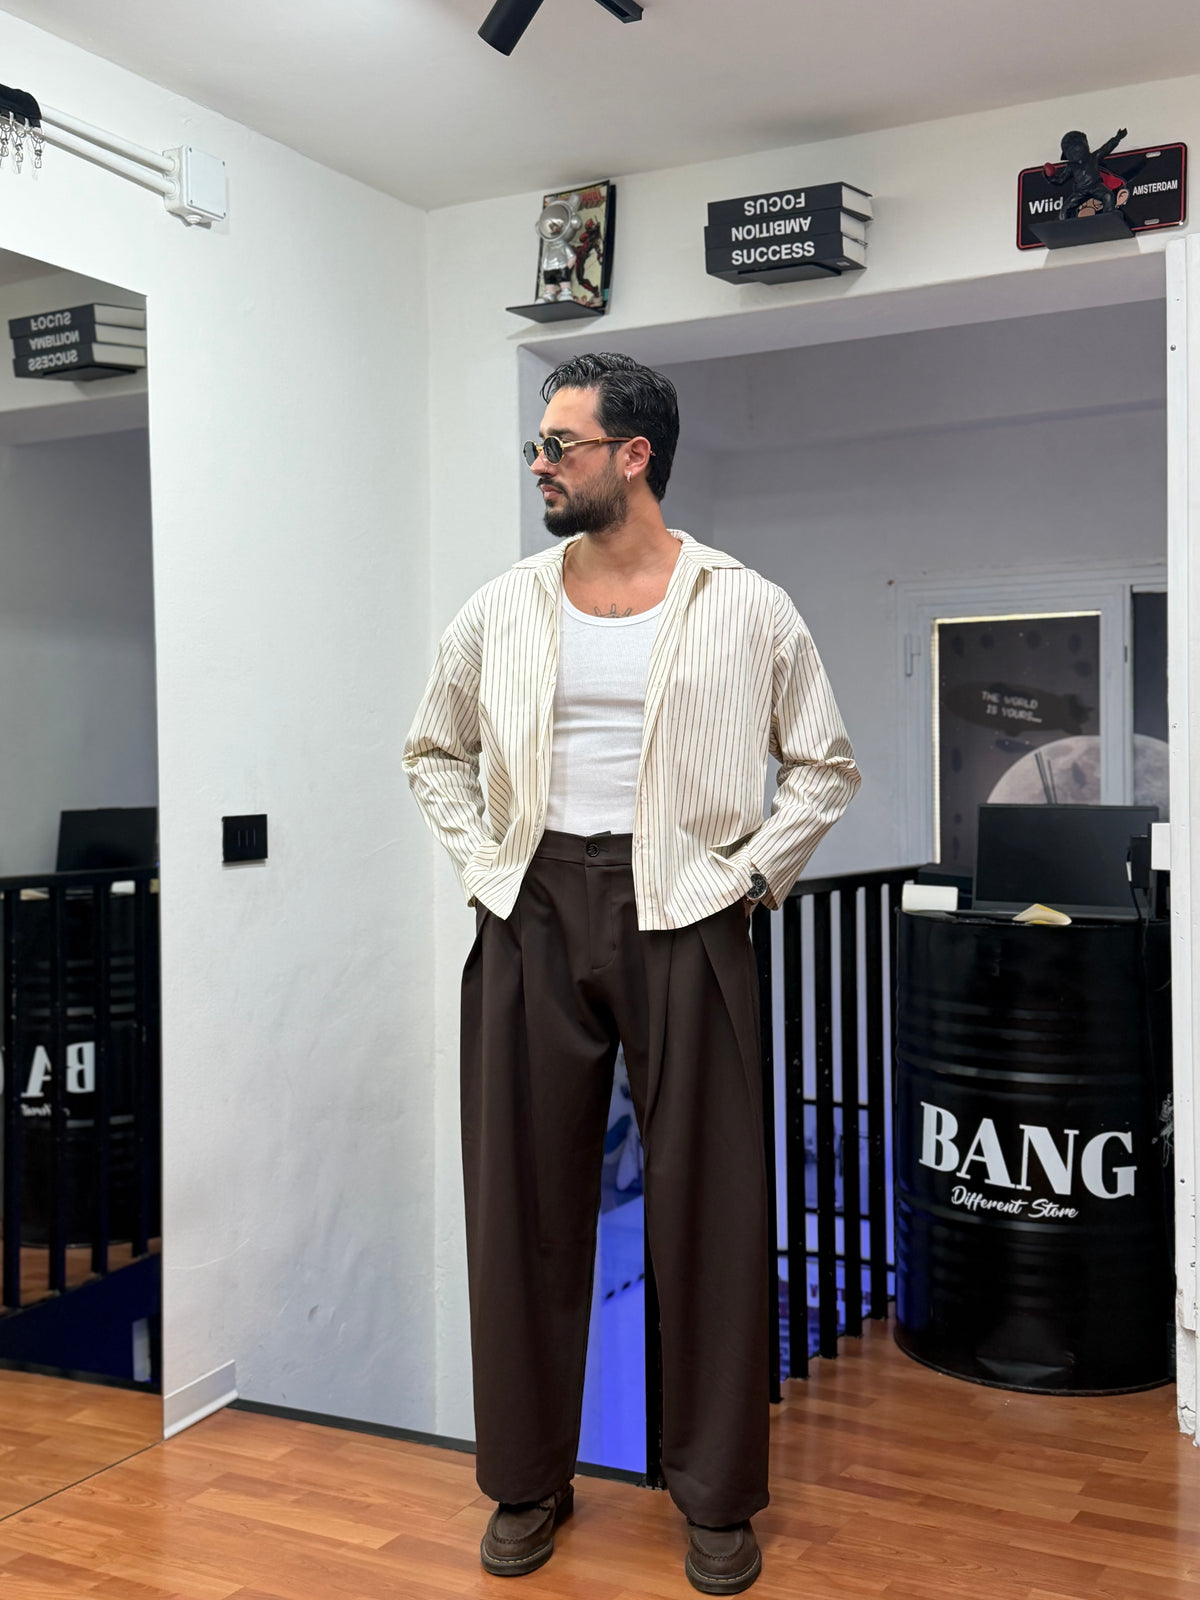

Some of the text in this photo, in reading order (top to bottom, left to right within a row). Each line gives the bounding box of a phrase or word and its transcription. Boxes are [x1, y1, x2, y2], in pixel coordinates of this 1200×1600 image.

[1132, 179, 1179, 196] AMSTERDAM
[743, 192, 806, 217] FOCUS
[731, 216, 812, 242] AMBITION
[731, 241, 815, 266] SUCCESS
[982, 691, 1038, 709] THE WORLD
[918, 1101, 1138, 1200] BANG
[951, 1185, 1080, 1219] Different Store
